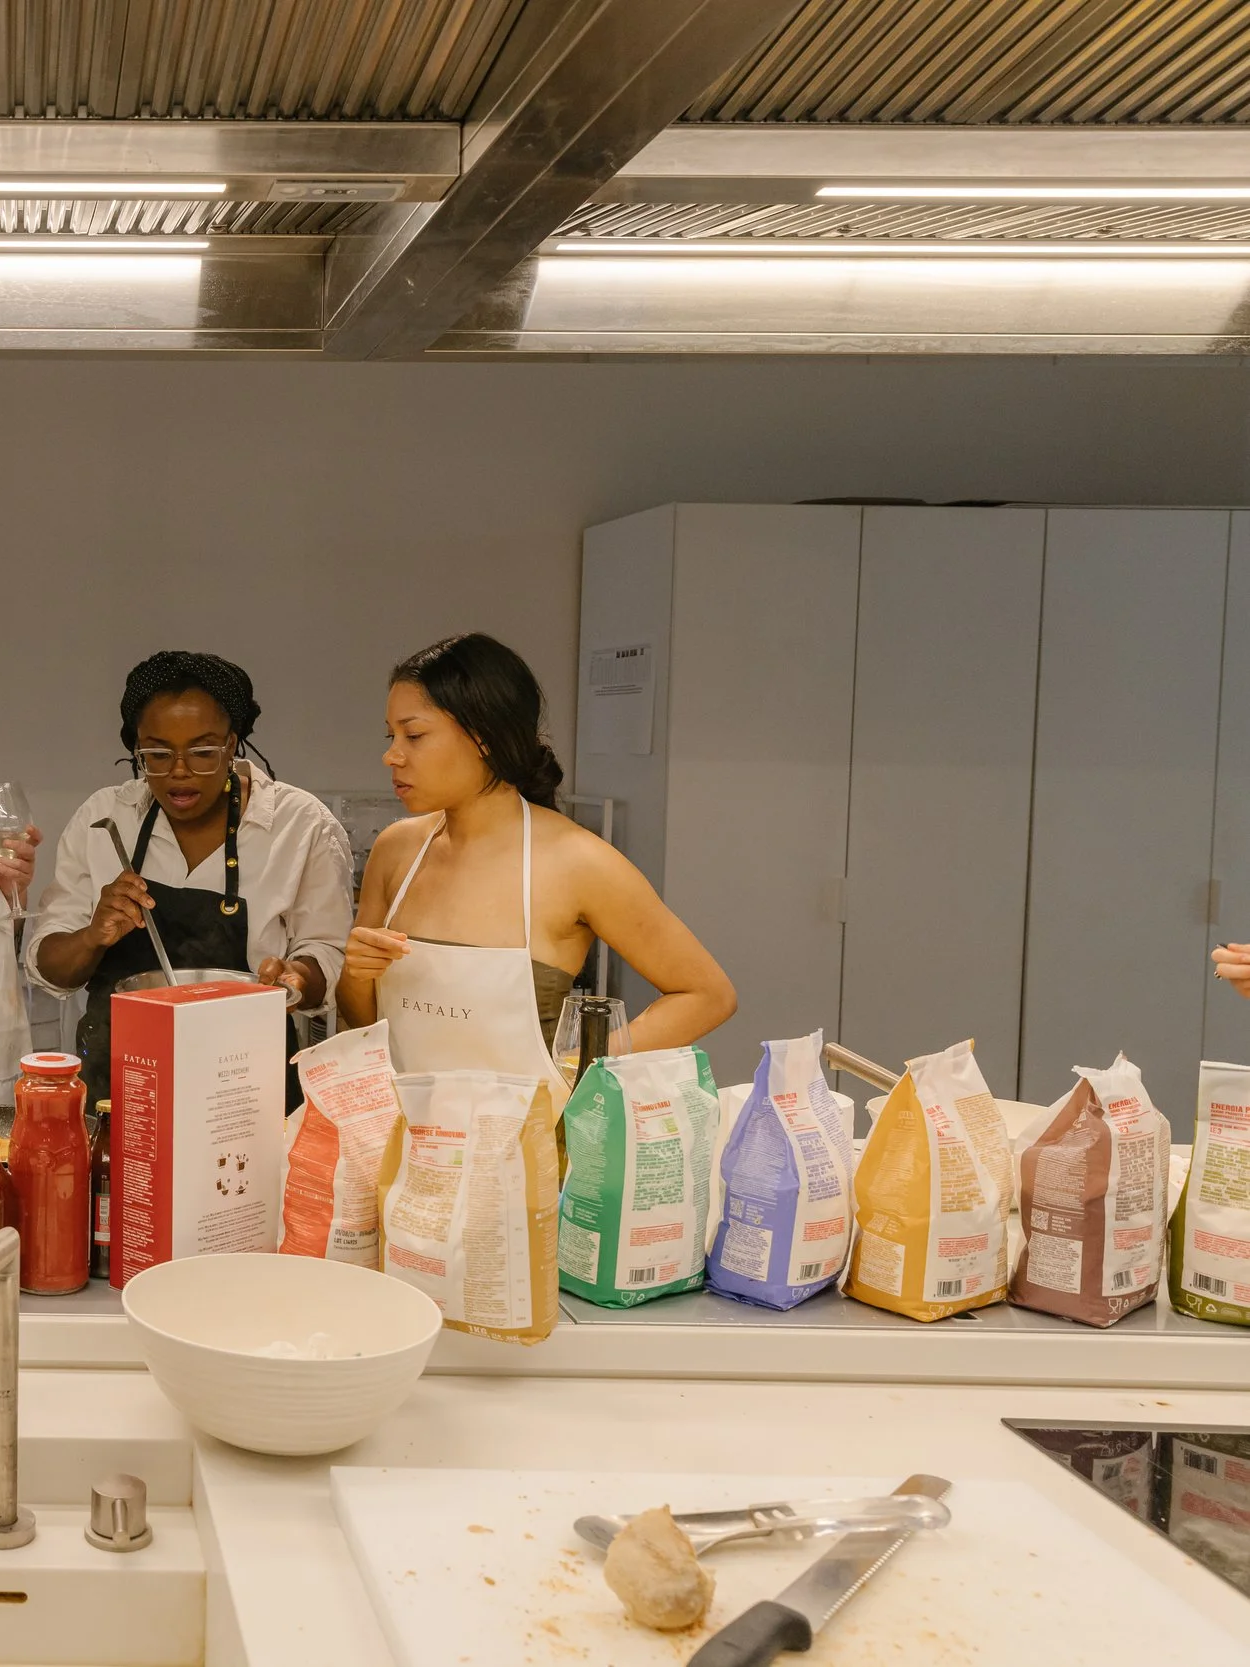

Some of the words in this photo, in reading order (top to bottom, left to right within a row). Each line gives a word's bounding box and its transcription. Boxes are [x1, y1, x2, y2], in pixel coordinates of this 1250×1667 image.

[402, 997, 471, 1019] EATALY
[124, 1054, 157, 1067] EATALY
[218, 1052, 250, 1064] EATALY
[1211, 1102, 1243, 1112] ENERGIA
